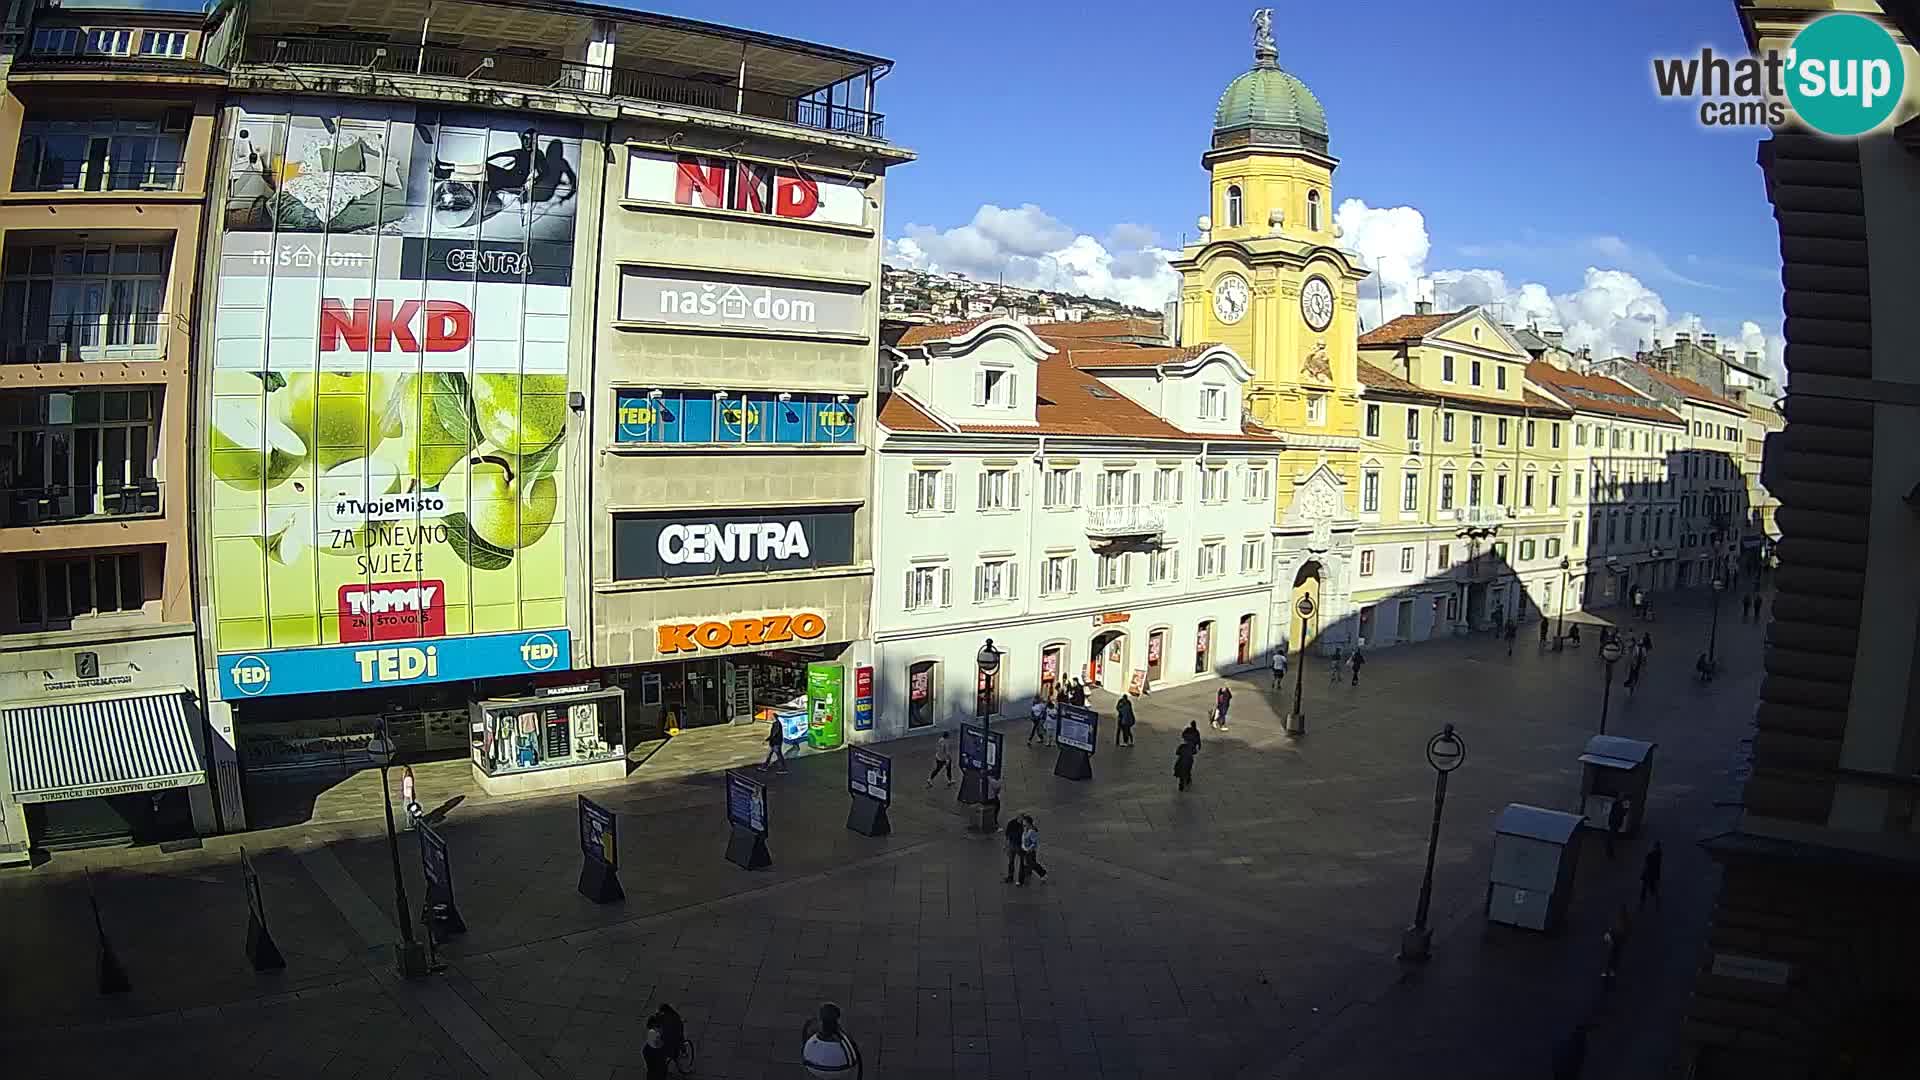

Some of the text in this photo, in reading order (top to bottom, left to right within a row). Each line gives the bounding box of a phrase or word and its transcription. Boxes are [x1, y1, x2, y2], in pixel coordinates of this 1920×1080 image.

[675, 158, 819, 219] NKD
[446, 249, 534, 274] CENTRA
[660, 284, 816, 322] naš dom
[319, 298, 474, 352] NKD
[618, 407, 657, 425] TEDi
[336, 497, 444, 516] #TvojeMisto
[331, 524, 449, 549] ZA DNEVNO
[658, 521, 810, 565] CENTRA
[357, 547, 424, 575] SVJEŽE
[346, 586, 438, 615] TOMMY
[658, 613, 827, 654] KORZO
[230, 641, 559, 685] TEDi TEDi TEDi
[86, 783, 144, 797] INFORMATIVNI
[147, 780, 179, 790] CENTAR
